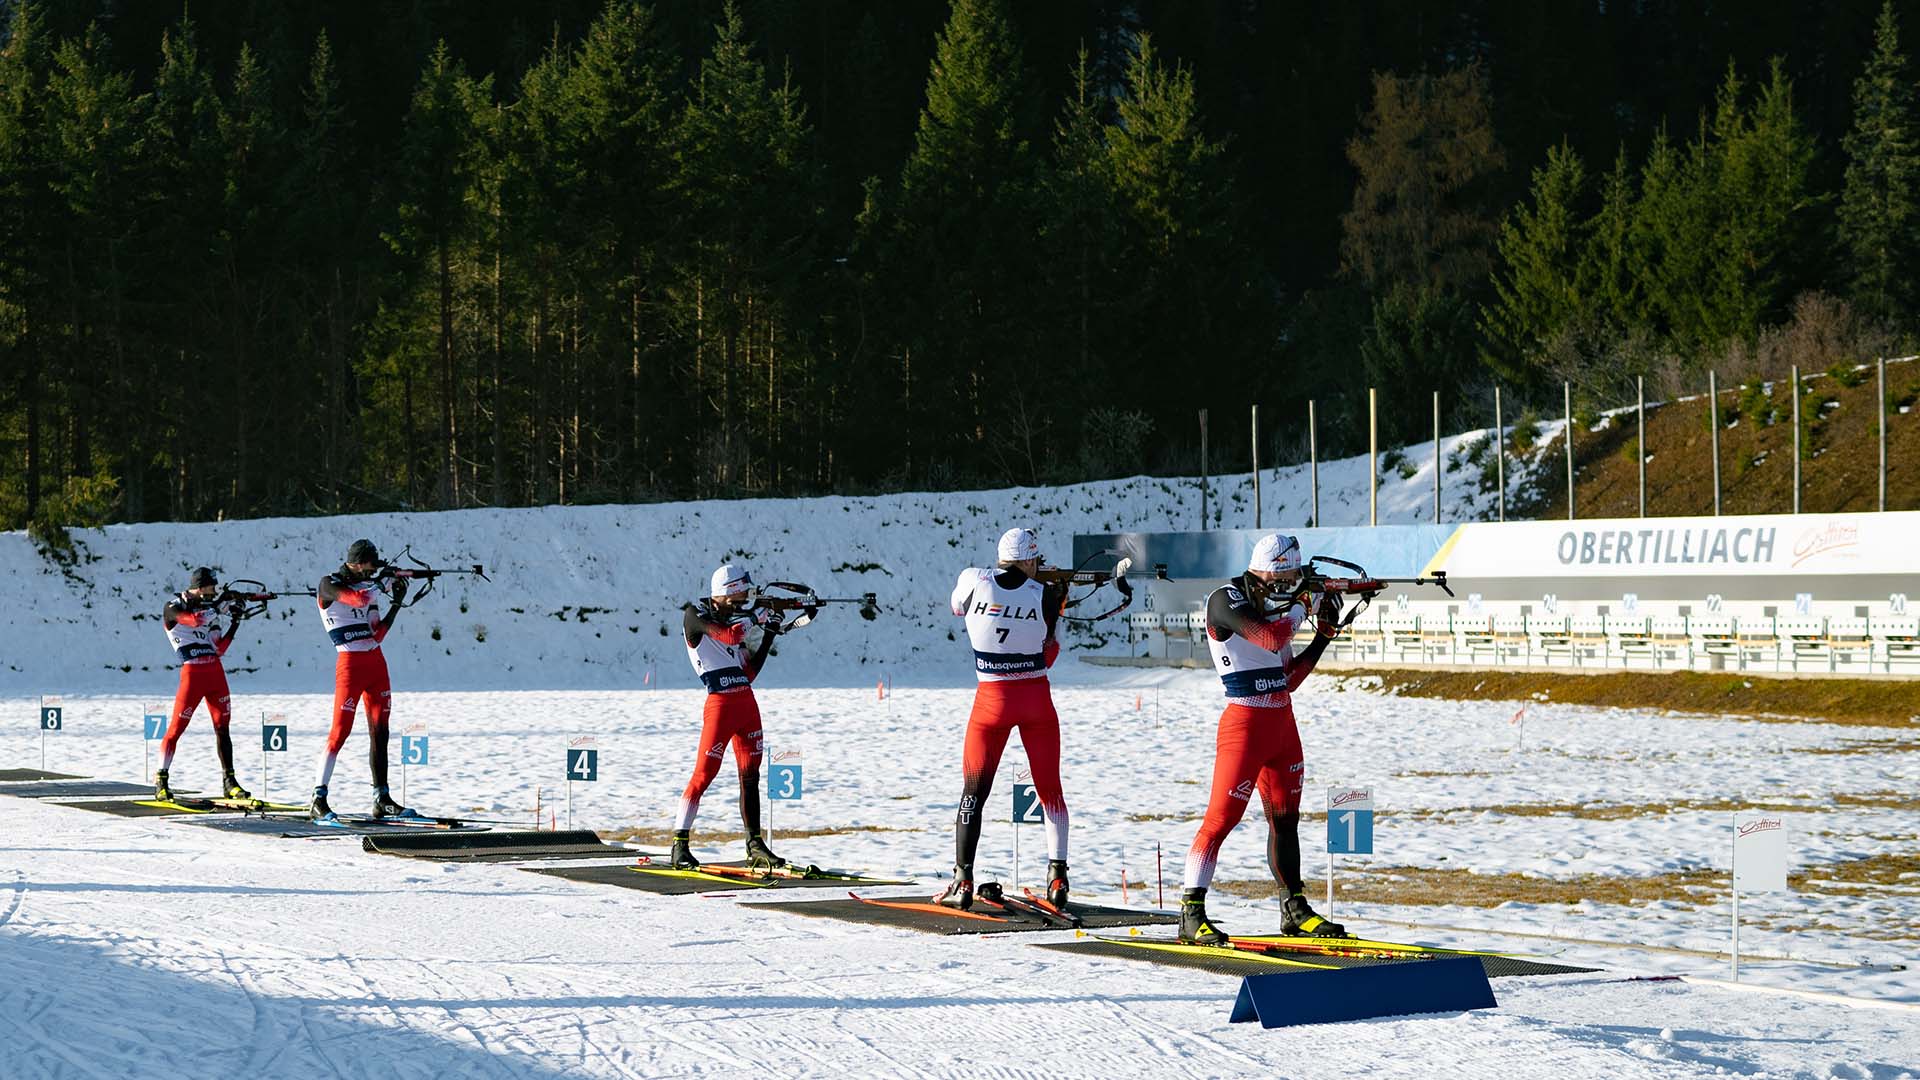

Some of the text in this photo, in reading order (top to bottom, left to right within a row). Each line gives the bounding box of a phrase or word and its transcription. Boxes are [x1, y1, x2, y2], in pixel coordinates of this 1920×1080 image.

[1557, 527, 1777, 565] OBERTILLIACH
[974, 601, 1038, 621] HELLA
[995, 628, 1010, 644] 7
[726, 647, 734, 659] 9
[1221, 655, 1231, 667] 8
[984, 660, 1035, 670] Husqvarna
[47, 709, 58, 730] 8
[151, 717, 163, 738] 7
[269, 727, 283, 751] 6
[407, 737, 422, 764] 5
[573, 750, 591, 779] 4
[779, 768, 794, 798] 3
[1023, 785, 1042, 821] 2
[1339, 811, 1355, 851] 1
[1311, 939, 1359, 947] FISCHER
